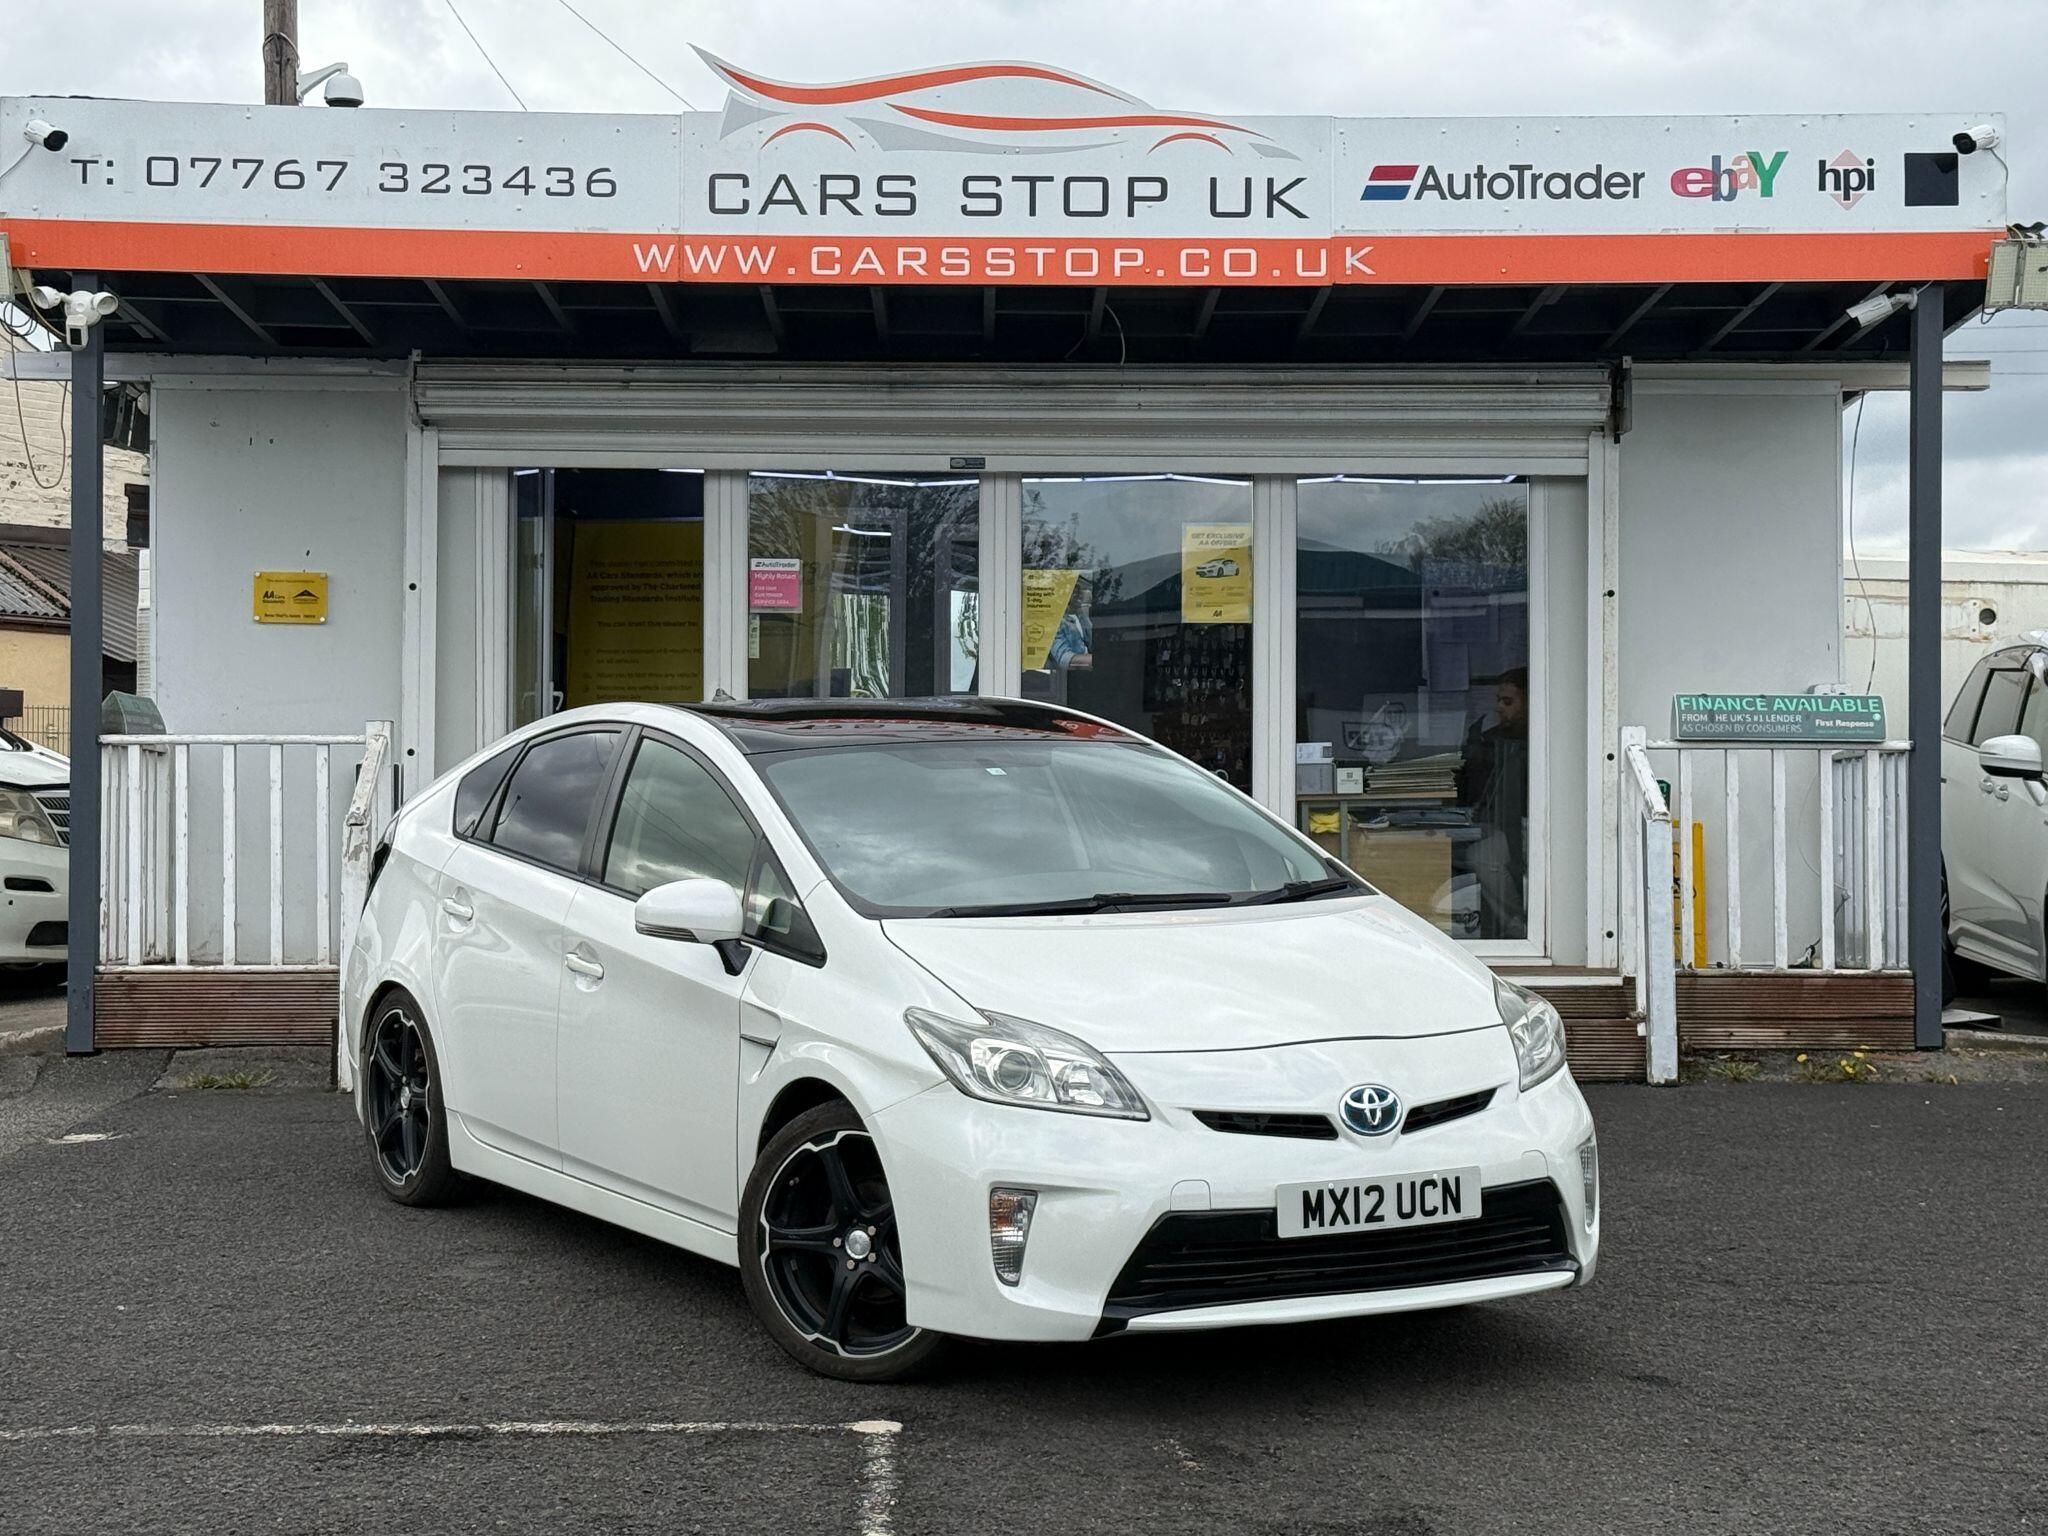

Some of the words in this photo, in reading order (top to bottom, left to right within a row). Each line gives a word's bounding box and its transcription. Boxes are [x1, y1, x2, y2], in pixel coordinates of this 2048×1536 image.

[71, 158, 115, 186] T:
[146, 156, 349, 192] 07767
[380, 162, 618, 198] 323436
[1414, 163, 1646, 201] AutoTrader
[1818, 157, 1876, 202] hpi
[708, 173, 918, 217] CARS
[961, 175, 1169, 218] STOP
[1209, 177, 1309, 219] UK
[633, 243, 1376, 278] WWW.CARSSTOP.CO.UK
[1679, 697, 1768, 712] FINANCE
[1773, 698, 1881, 714] AVAILABLE
[1681, 714, 1708, 722] FROM
[1730, 714, 1752, 722] UK'S
[1765, 714, 1802, 723] LENDER
[1681, 724, 1694, 732] AS
[1694, 724, 1732, 733] CHOSEN
[1734, 725, 1746, 733] BY
[1746, 724, 1802, 734] CONSUMERS
[1815, 719, 1834, 727] First
[1835, 719, 1875, 729] Response
[1302, 1184, 1386, 1229] MX12
[1396, 1175, 1463, 1220] UCN
